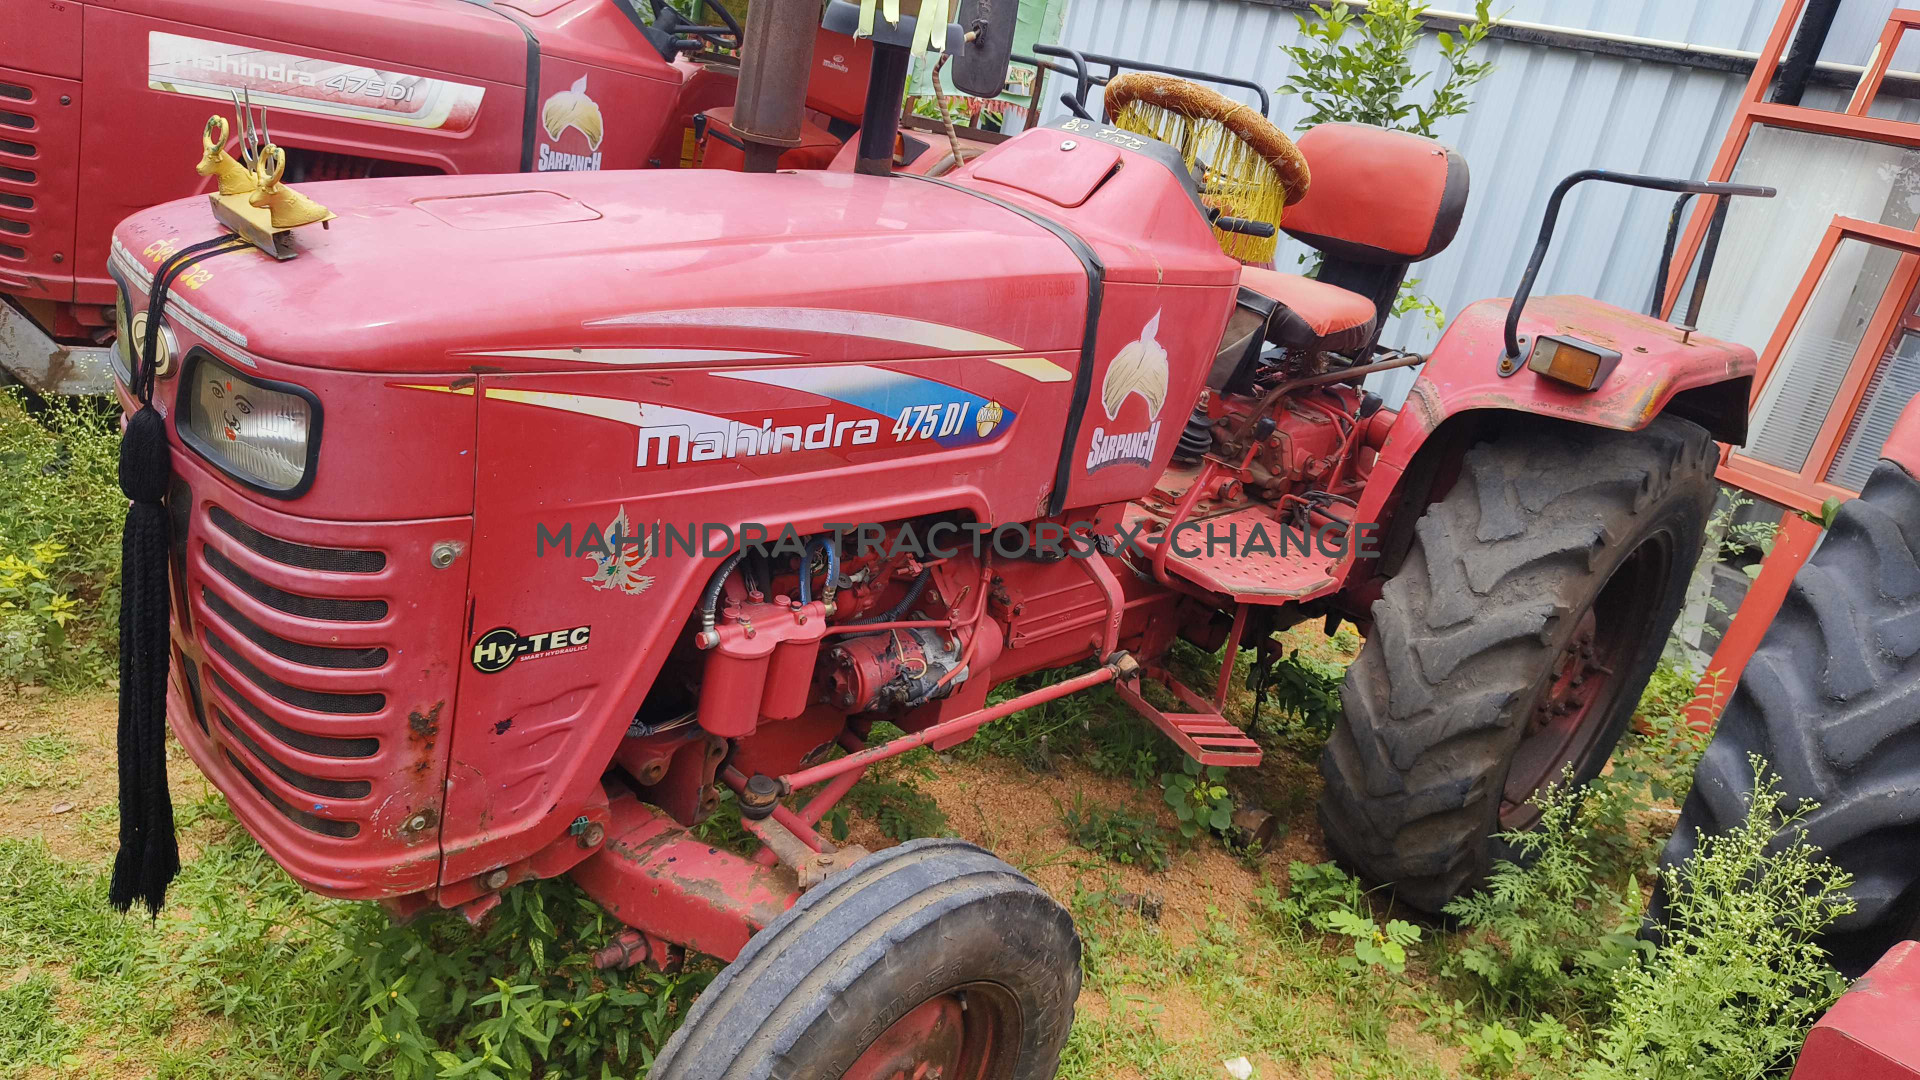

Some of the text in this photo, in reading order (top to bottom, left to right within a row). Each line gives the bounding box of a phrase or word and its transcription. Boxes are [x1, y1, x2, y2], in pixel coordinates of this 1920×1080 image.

[538, 143, 602, 171] SARPANCH
[636, 401, 971, 468] Mahindra 475 DI
[1086, 419, 1161, 470] SARPANCH
[473, 626, 590, 664] Hy-TEC
[520, 645, 588, 662] SMART HYDRAULICS
